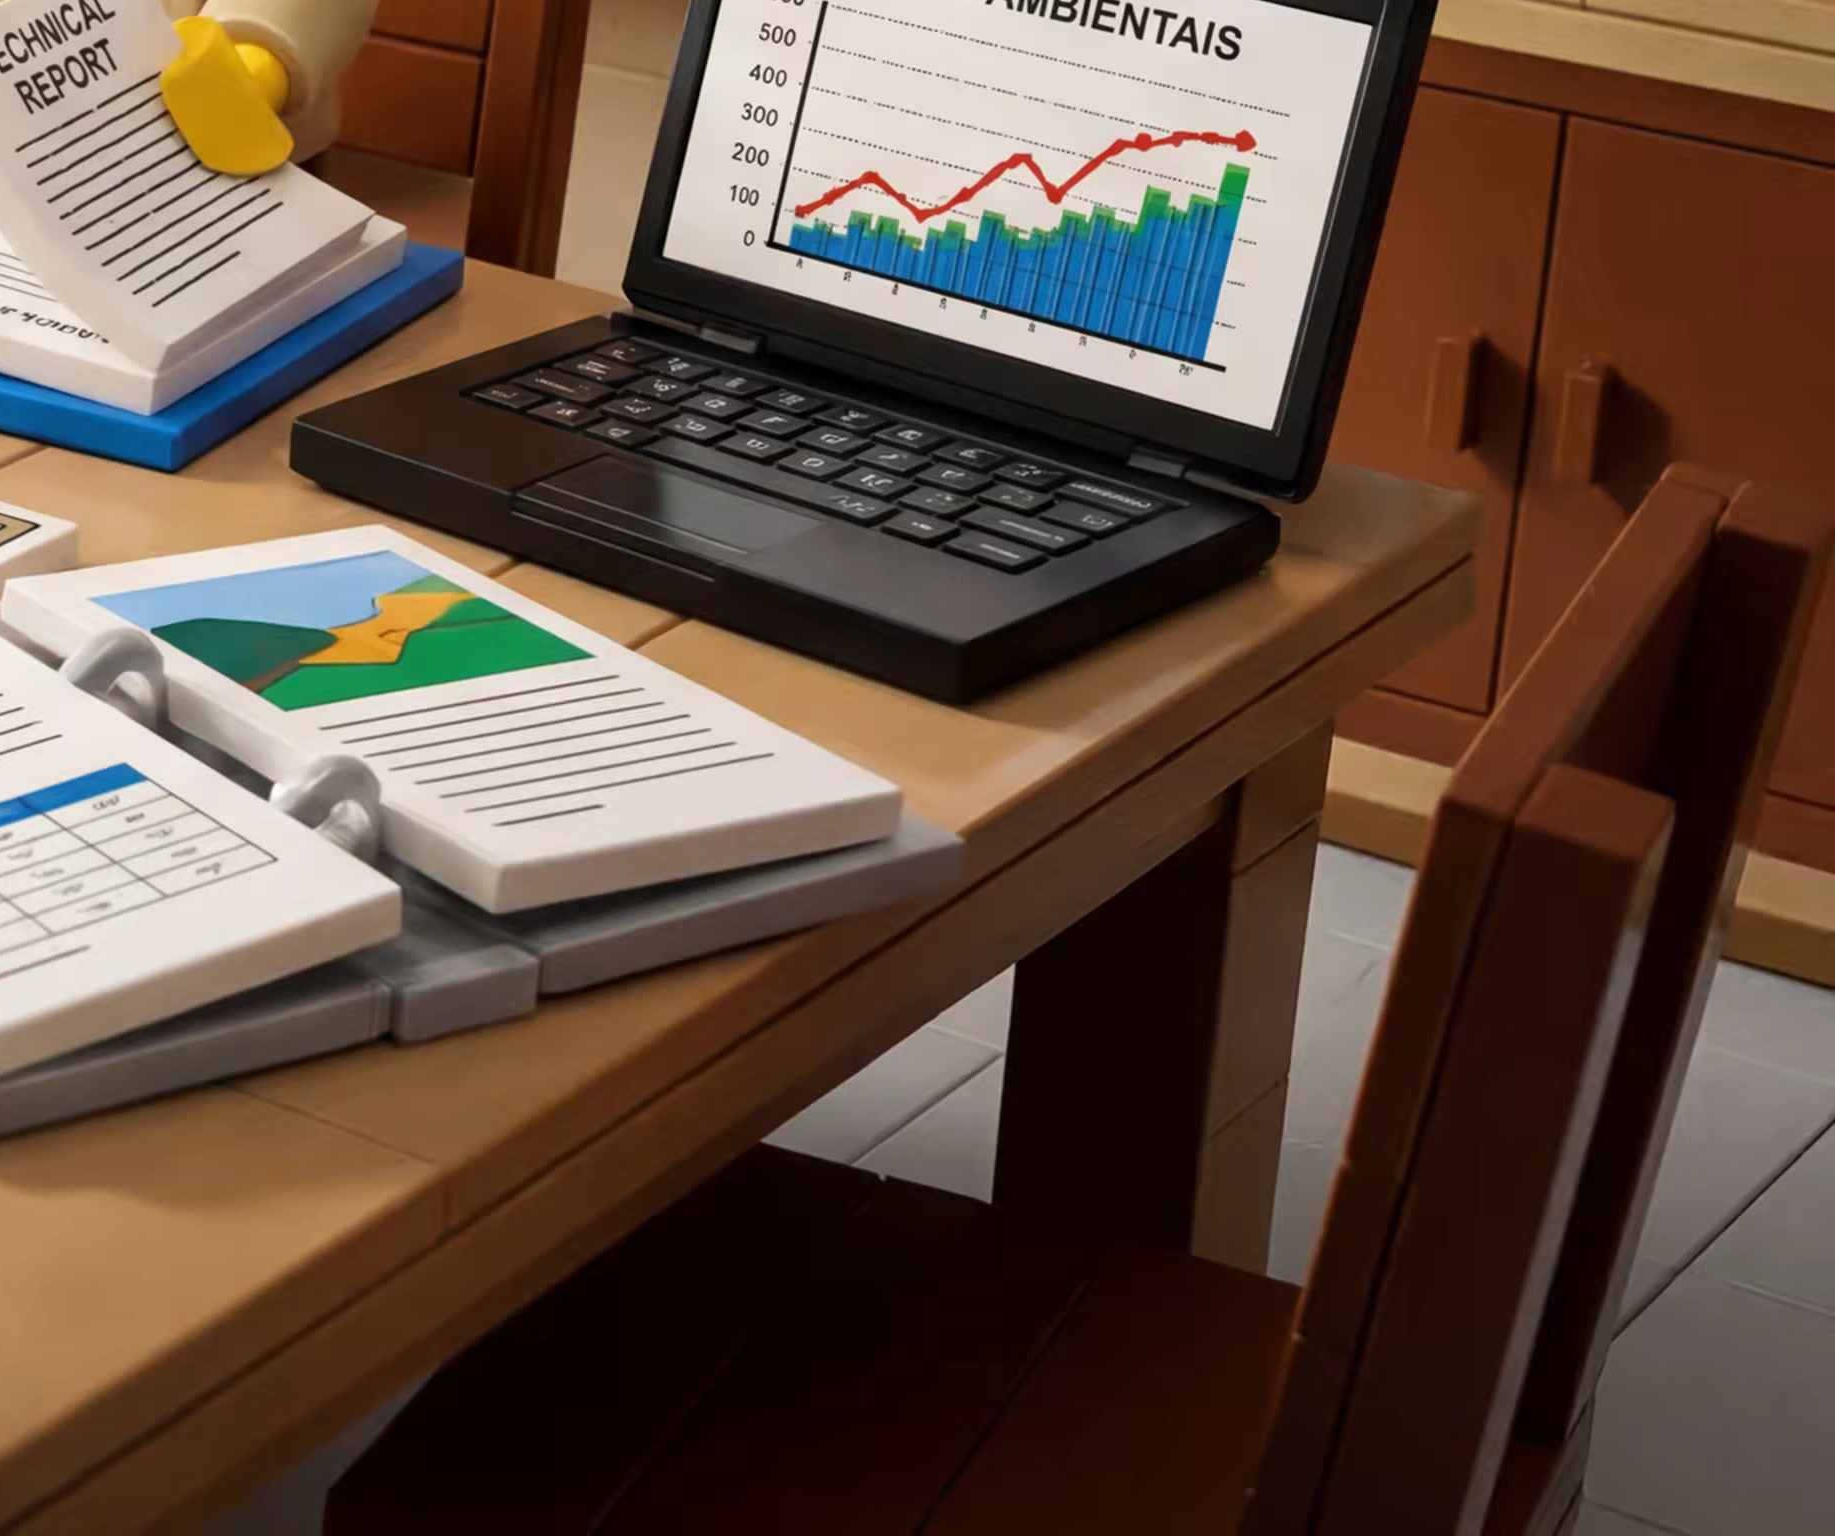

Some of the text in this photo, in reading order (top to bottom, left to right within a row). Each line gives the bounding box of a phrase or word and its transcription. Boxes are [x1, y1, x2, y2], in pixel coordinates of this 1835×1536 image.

[758, 23, 797, 47] 500
[13, 37, 118, 115] REPORT
[748, 64, 788, 89] 400
[741, 102, 779, 128] 300
[731, 142, 770, 167] 200
[728, 184, 761, 208] 100
[742, 230, 756, 248] 0
